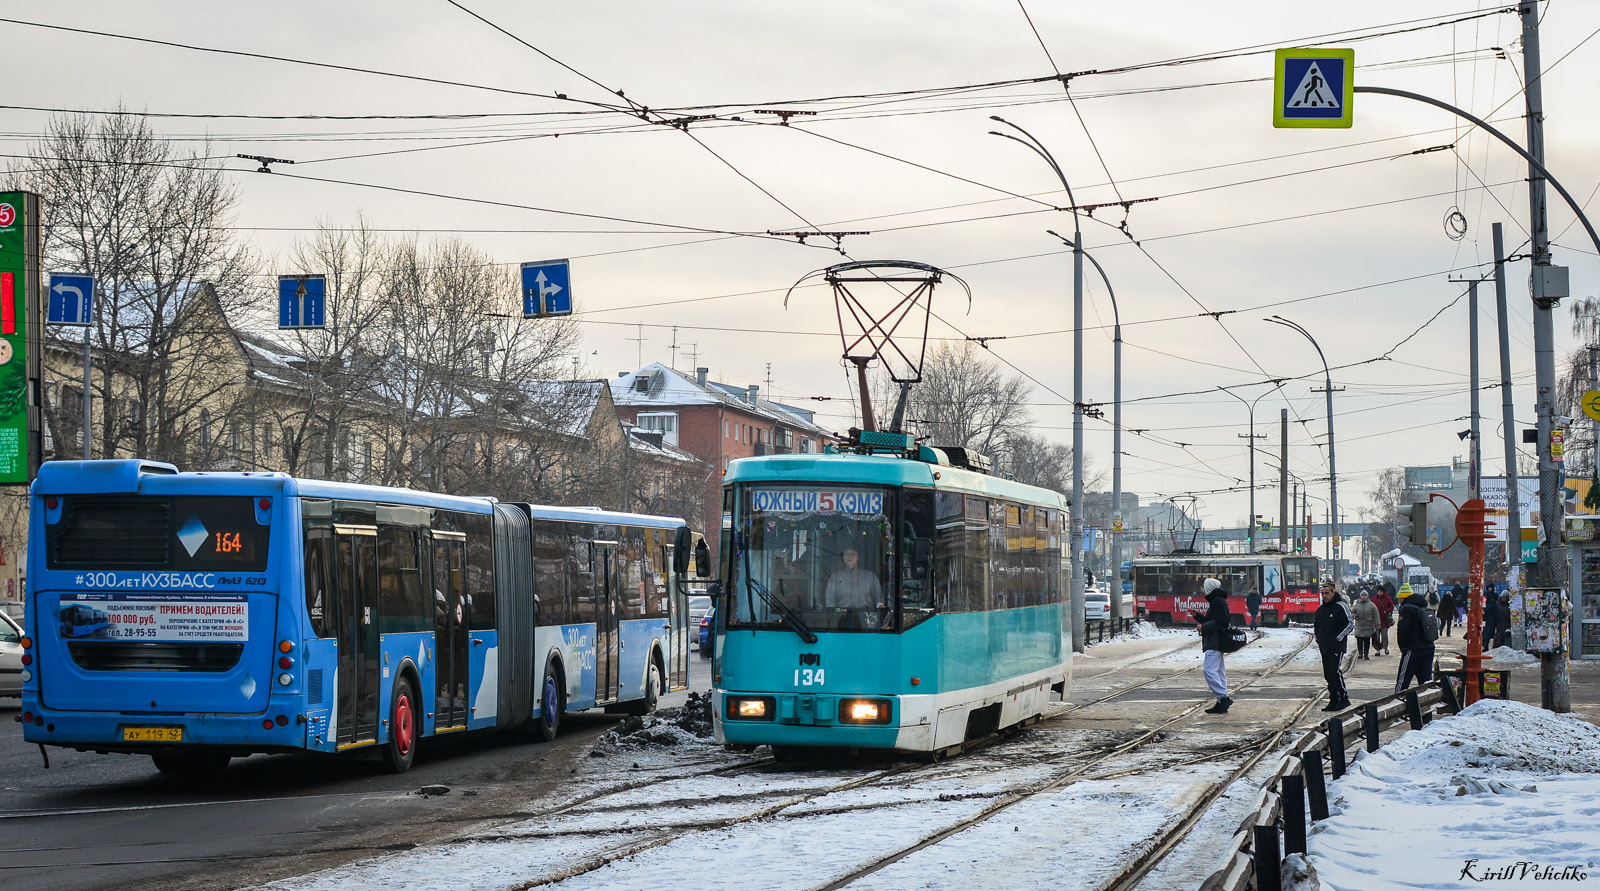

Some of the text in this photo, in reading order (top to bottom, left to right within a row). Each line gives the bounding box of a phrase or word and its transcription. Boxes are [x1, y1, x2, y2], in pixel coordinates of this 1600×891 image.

[754, 491, 882, 514] ЮЖНЫЙ 5 КЭМЗ
[216, 532, 242, 552] 164
[160, 604, 244, 616] ПРИМЕМ ВОДИТЕЛЕЙ!
[108, 614, 156, 626] 100 000 руб.
[124, 628, 156, 636] 28-95-55
[794, 668, 825, 686] 134
[146, 730, 163, 739] 119
